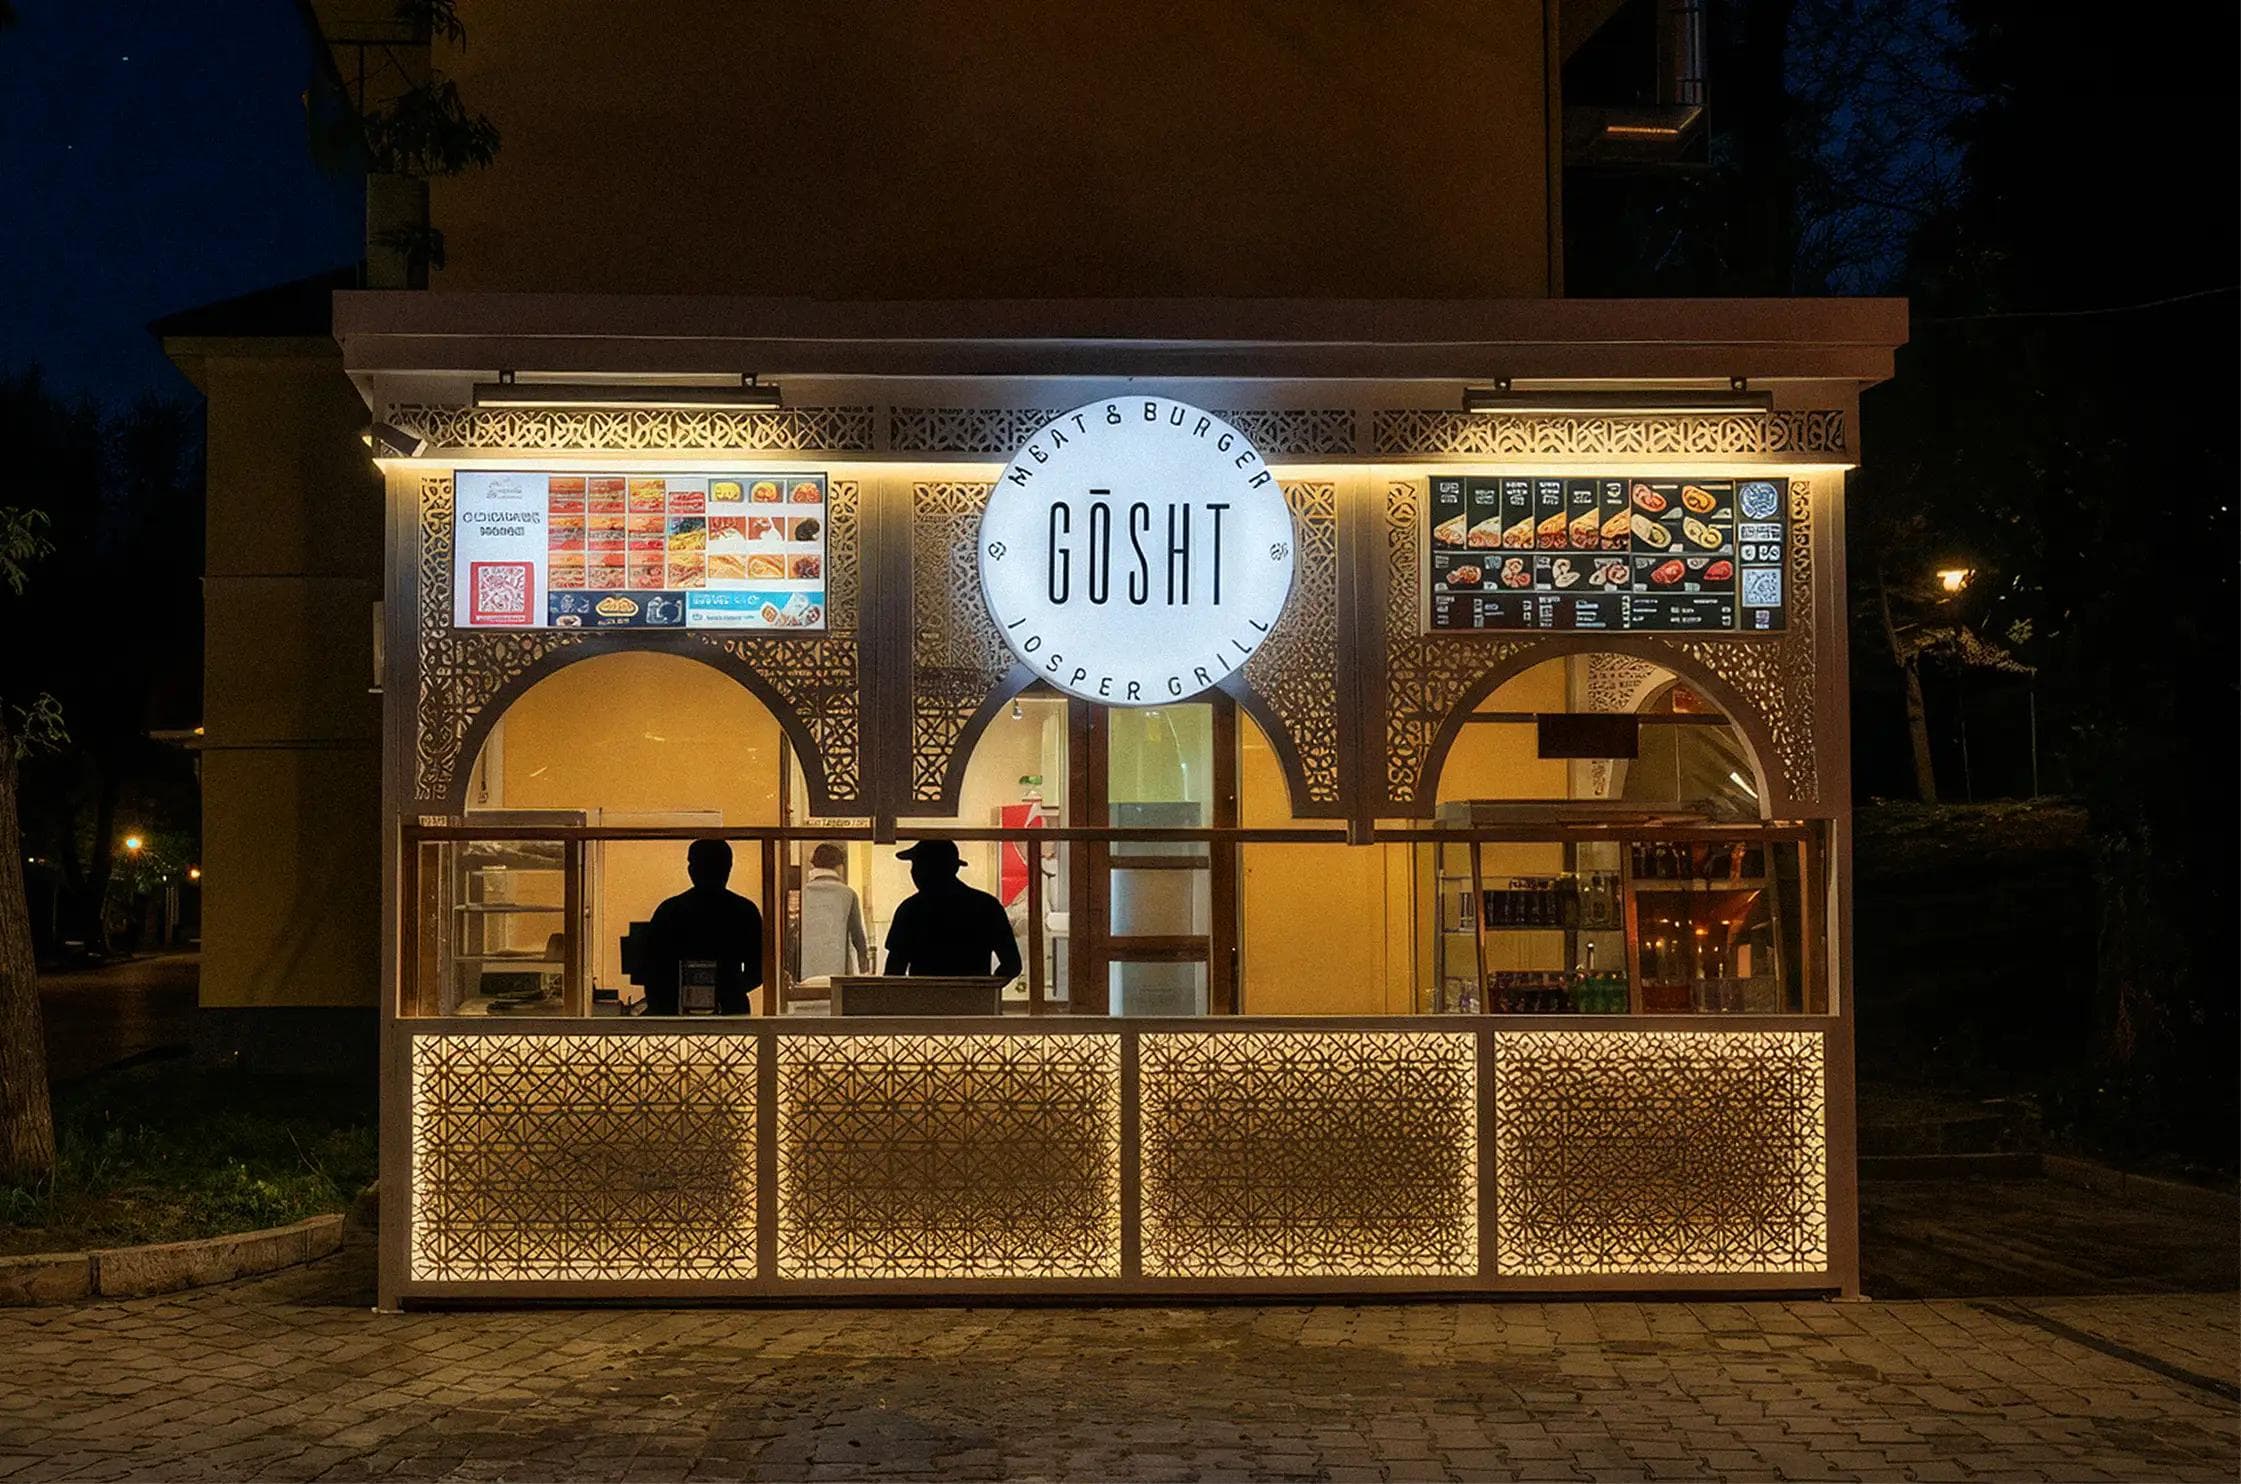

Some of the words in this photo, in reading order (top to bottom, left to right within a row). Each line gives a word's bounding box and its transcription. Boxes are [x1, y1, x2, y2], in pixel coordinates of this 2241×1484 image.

[1008, 413, 1086, 487] MEAT
[1106, 404, 1121, 424] &
[1144, 402, 1271, 489] BURGER
[1168, 619, 1268, 695] GRILL
